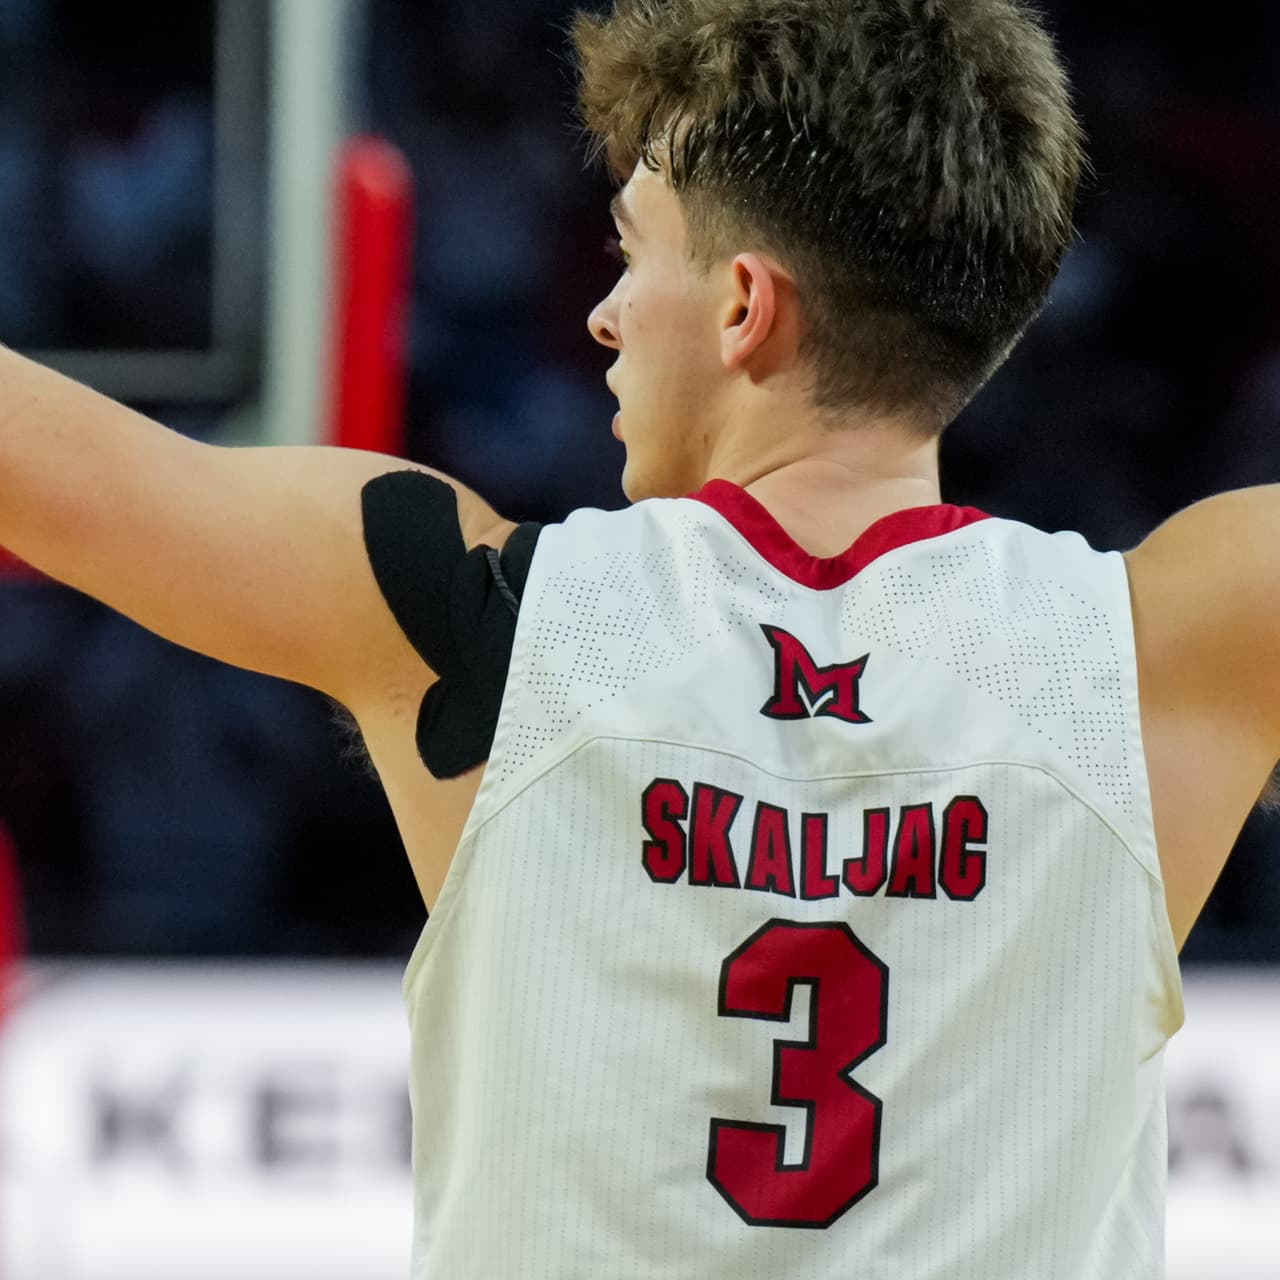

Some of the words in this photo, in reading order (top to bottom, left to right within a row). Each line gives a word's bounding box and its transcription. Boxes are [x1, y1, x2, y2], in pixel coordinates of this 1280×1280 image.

[760, 623, 873, 724] M
[641, 777, 989, 901] SKALJAC
[86, 1055, 414, 1188] KE
[706, 918, 889, 1229] 3
